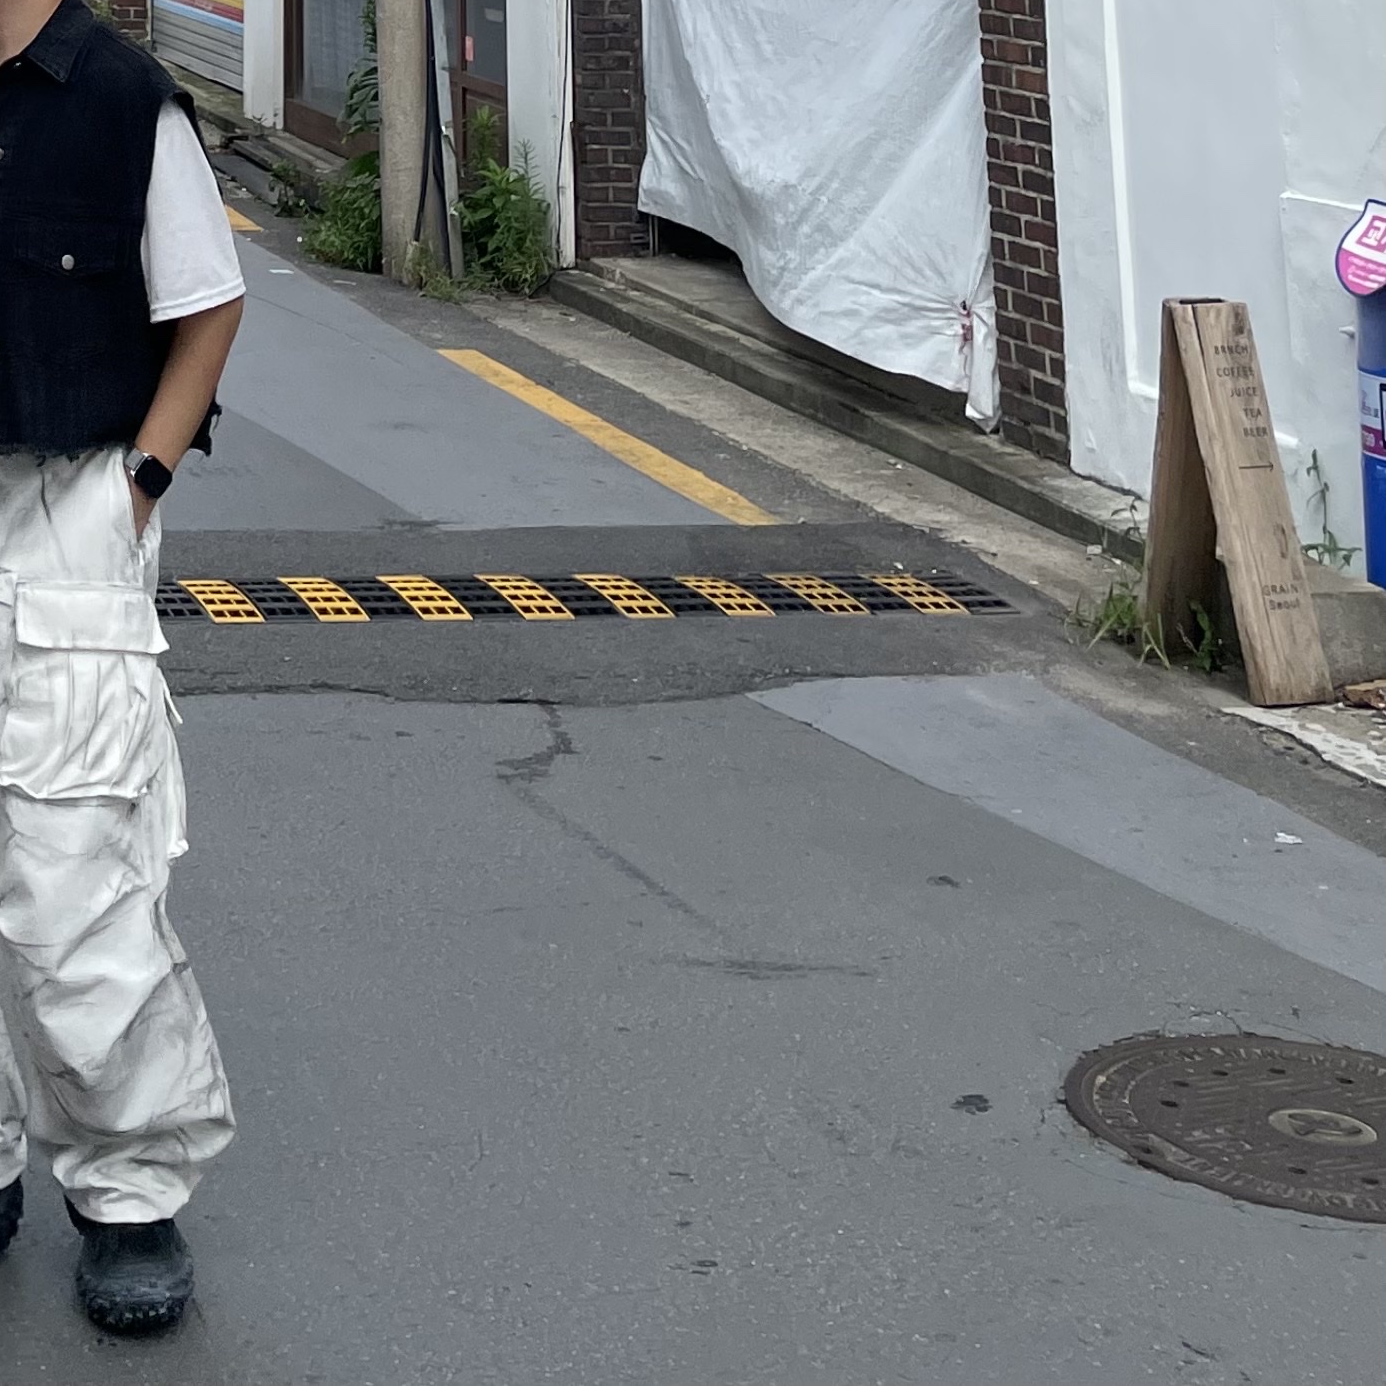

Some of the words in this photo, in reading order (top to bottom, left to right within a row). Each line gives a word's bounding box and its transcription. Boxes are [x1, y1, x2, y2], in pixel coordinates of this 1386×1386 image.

[1230, 386, 1258, 398] JUICE
[1243, 408, 1262, 419] TEA
[1243, 427, 1268, 438] BEER
